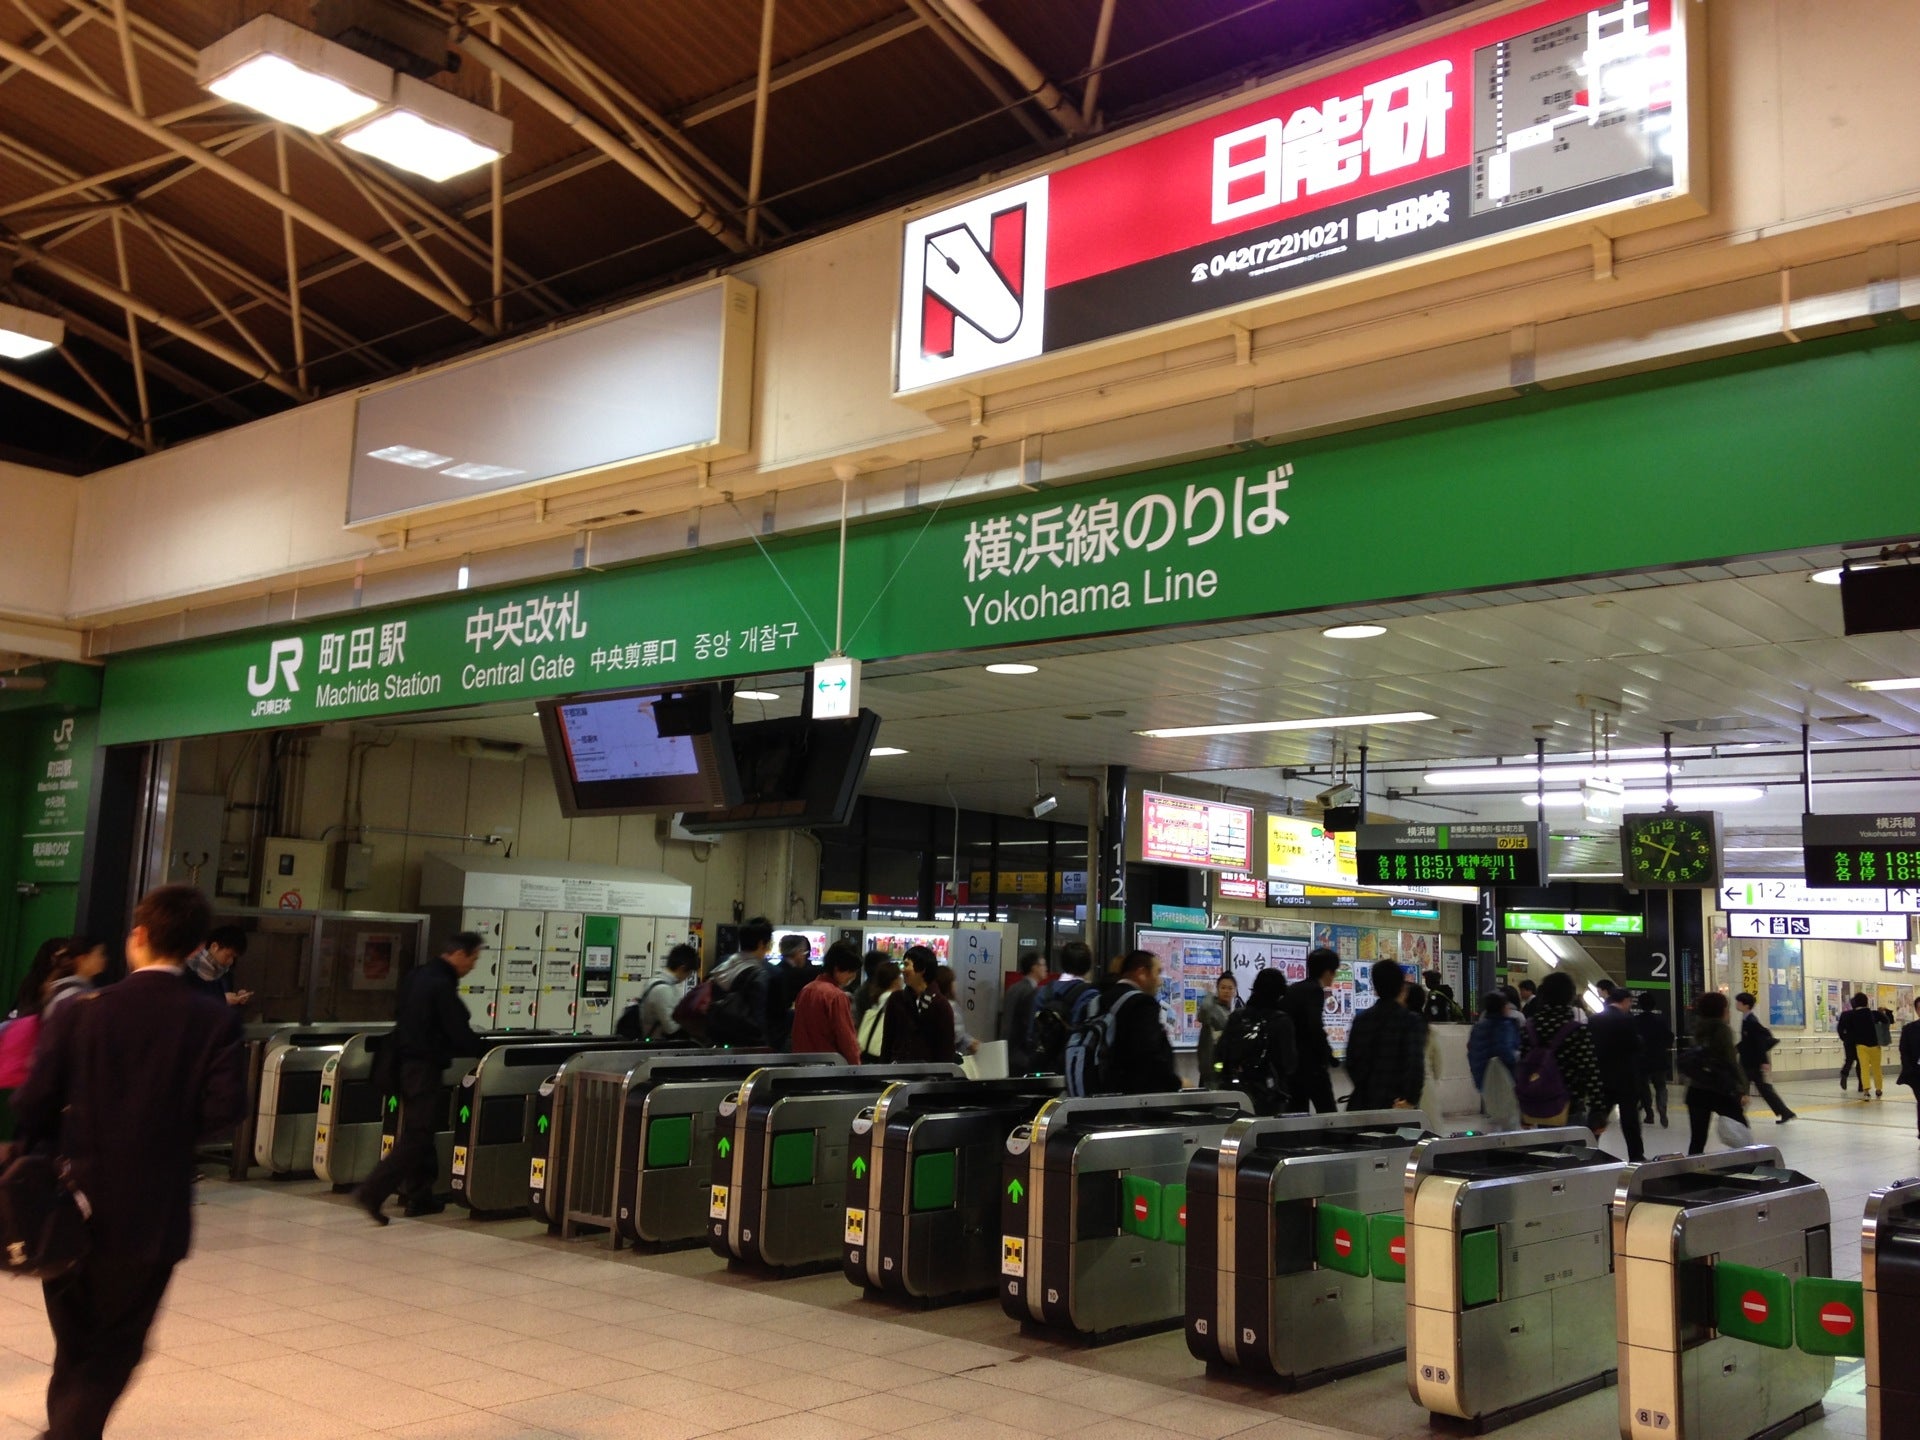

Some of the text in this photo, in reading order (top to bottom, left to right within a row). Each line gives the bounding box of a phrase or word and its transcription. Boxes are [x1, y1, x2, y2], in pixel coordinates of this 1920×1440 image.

[1211, 59, 1453, 224] 日能研
[1356, 190, 1450, 242] 町田校
[963, 462, 1295, 582] 横浜線のりば
[964, 566, 1218, 627] Yokohama Line
[465, 590, 588, 653] 中央改札
[694, 622, 799, 660] 중앙 개찰구
[318, 621, 407, 674] 町田駅
[590, 639, 677, 674] 中央剪票口
[247, 637, 303, 697] JR
[462, 653, 576, 690] Central Gate
[316, 671, 441, 708] Machida Station
[251, 697, 292, 717] JR東日本
[53, 718, 74, 743] JR
[1662, 821, 1673, 830] 12
[1876, 817, 1916, 829] 横浜線
[1407, 826, 1436, 837] 横浜線
[1691, 831, 1699, 840] 2
[1499, 838, 1525, 848] のりば
[1635, 847, 1642, 855] 9
[1698, 845, 1706, 854] 3
[1414, 855, 1453, 867] 18:51
[1456, 855, 1505, 867] 東神奈川
[1509, 855, 1516, 867] 1
[1641, 860, 1649, 869] 8
[1693, 859, 1700, 867] 4
[1415, 867, 1454, 880] 18:57
[1509, 867, 1516, 880] 1
[1654, 869, 1661, 877] 7
[1667, 870, 1675, 879] 6
[1681, 868, 1688, 876] 5
[1631, 917, 1640, 931] 2
[1233, 952, 1266, 970] 仙台
[1651, 952, 1668, 977] 2
[966, 935, 978, 1011] acure
[1198, 1321, 1207, 1332] 10
[1246, 1330, 1252, 1341] 9
[1425, 1368, 1432, 1380] 9
[1438, 1369, 1445, 1381] 8
[1640, 1411, 1648, 1422] 8
[1657, 1414, 1664, 1425] 7
